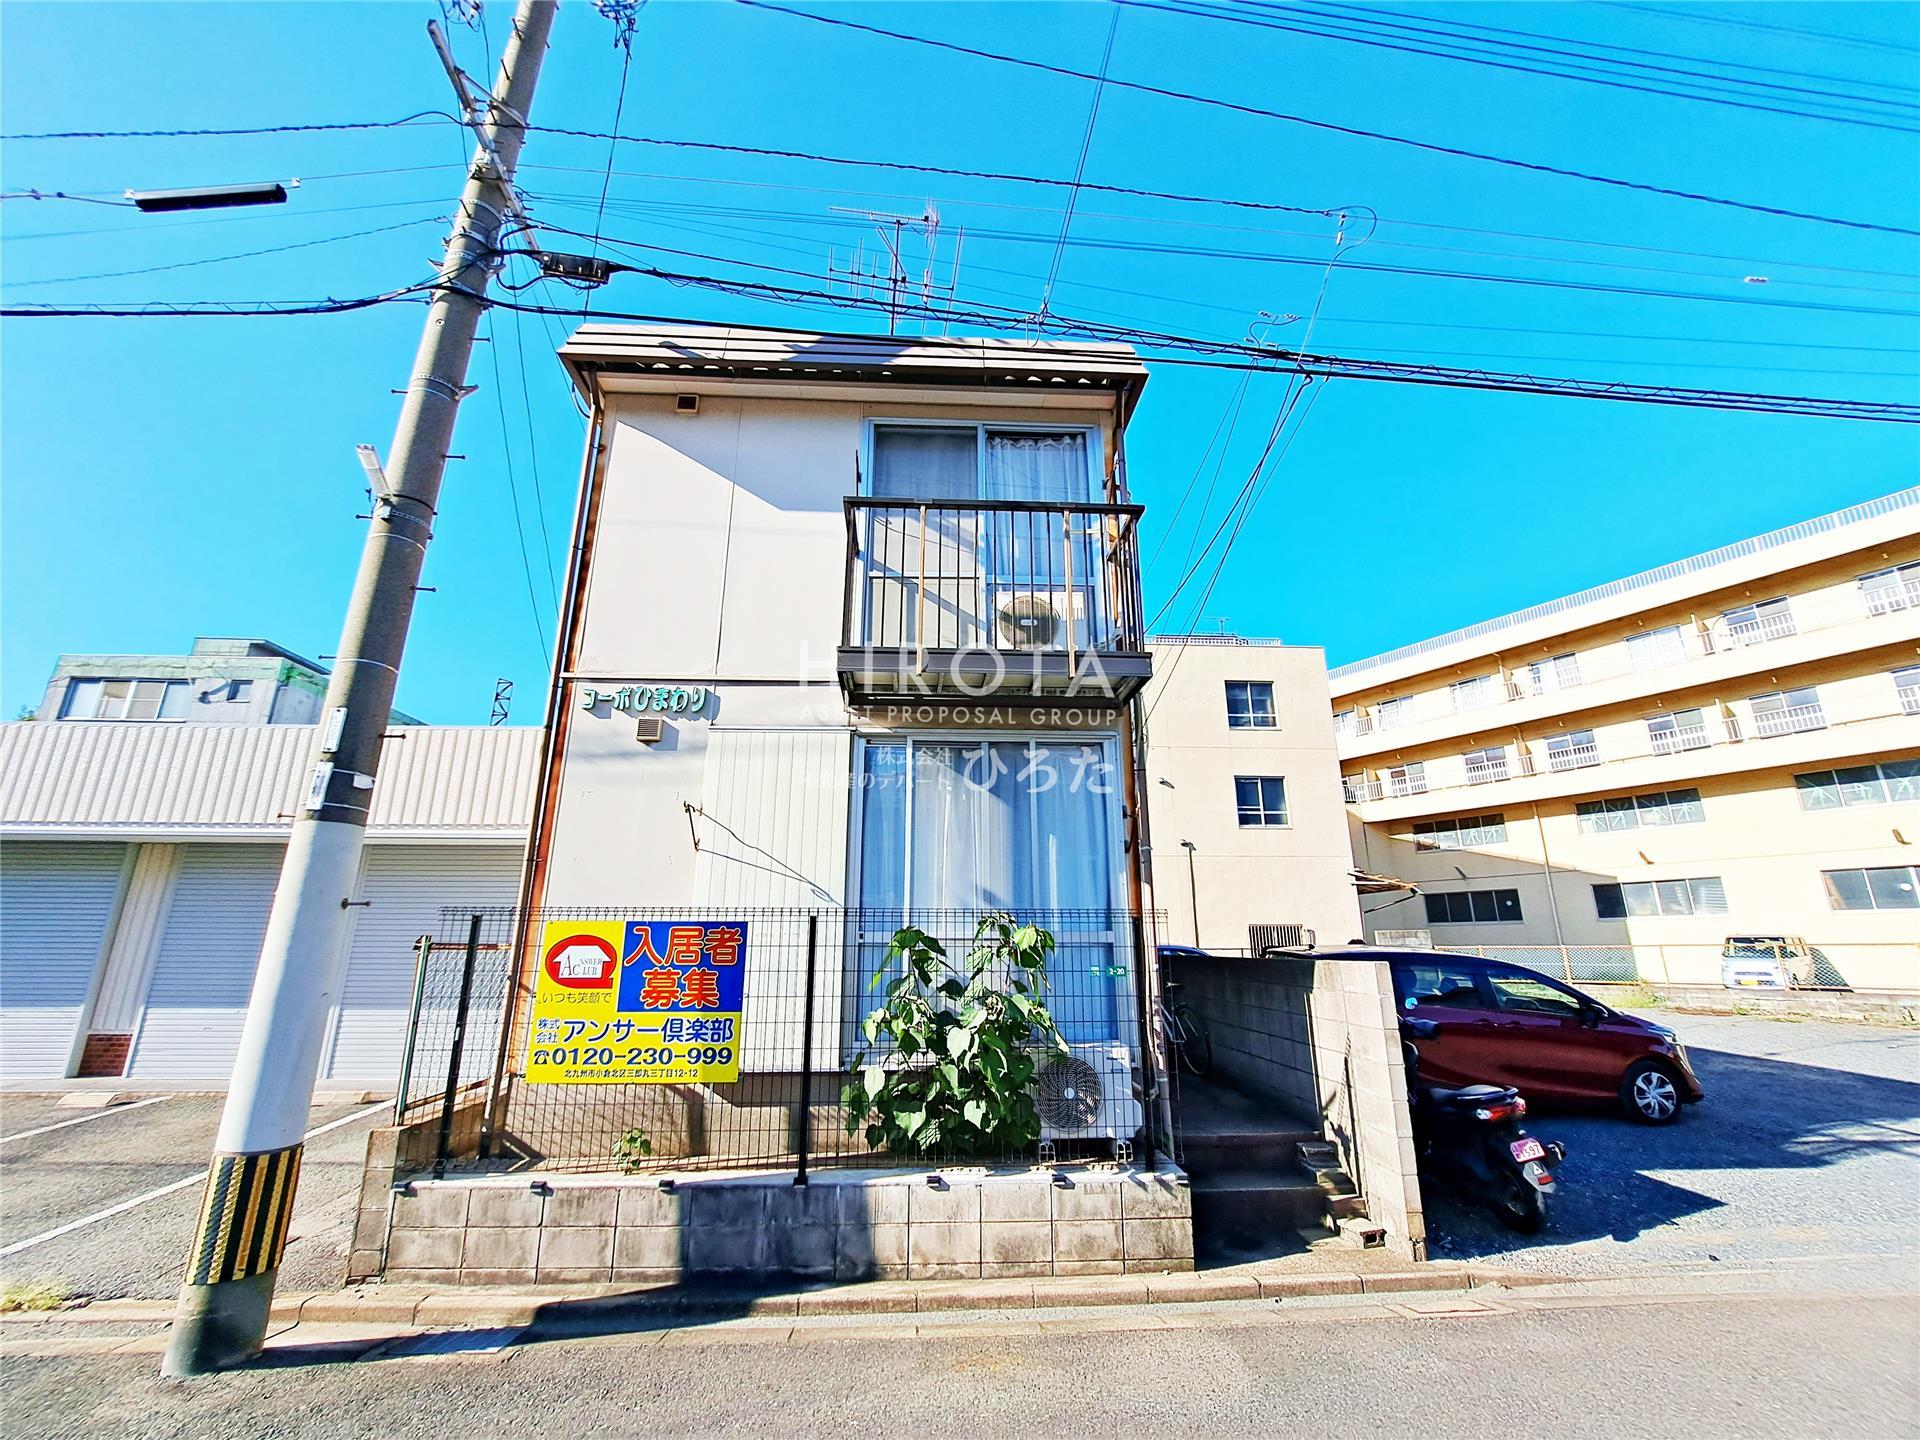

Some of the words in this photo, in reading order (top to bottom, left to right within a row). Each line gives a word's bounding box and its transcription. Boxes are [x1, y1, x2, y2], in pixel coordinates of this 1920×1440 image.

[582, 686, 706, 712] コーポひまわり
[624, 926, 743, 966] 入居者
[542, 992, 612, 1004] いつも笑顔で
[640, 968, 719, 1008] 募集
[563, 1018, 733, 1043] アンサー倶楽部
[551, 1047, 732, 1066] 0120-230-999
